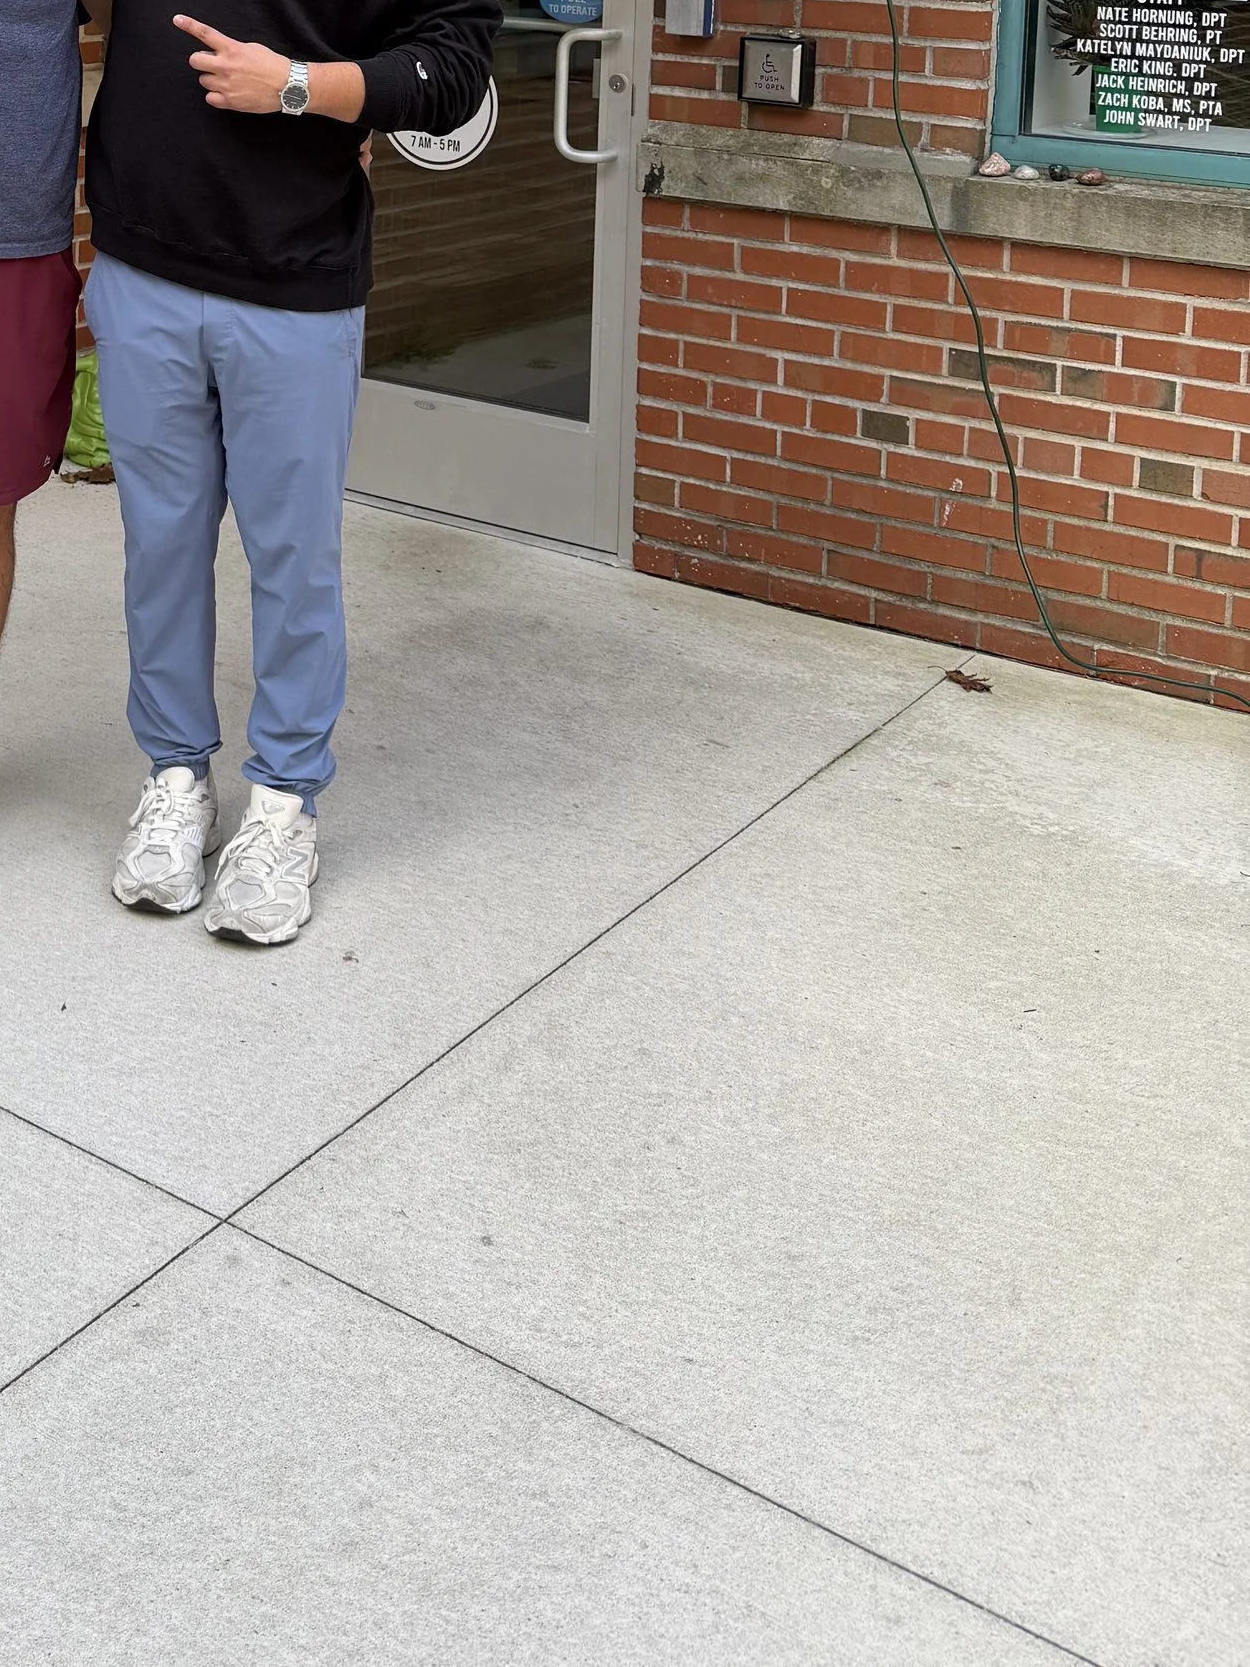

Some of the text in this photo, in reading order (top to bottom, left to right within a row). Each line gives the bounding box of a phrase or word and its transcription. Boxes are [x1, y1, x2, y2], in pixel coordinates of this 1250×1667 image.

[549, 4, 597, 16] TO OPERATE
[1097, 6, 1227, 27] NATE HORNUNG, DPT
[1100, 23, 1222, 45] SCOTT BEHRING, PT
[1076, 39, 1245, 64] KATELYN MAYDANIUK, DPT
[1111, 58, 1139, 73] ERIC
[1181, 64, 1206, 78] DPT
[1096, 74, 1218, 97] JACK HEINRICH, DPT
[1098, 92, 1223, 116] ZACH KOBA, MS, PTA
[1103, 110, 1213, 132] JOHN SWART, DPT
[411, 135, 416, 147] 7
[418, 137, 431, 149] AM
[439, 138, 445, 151] 5
[447, 140, 461, 152] PM
